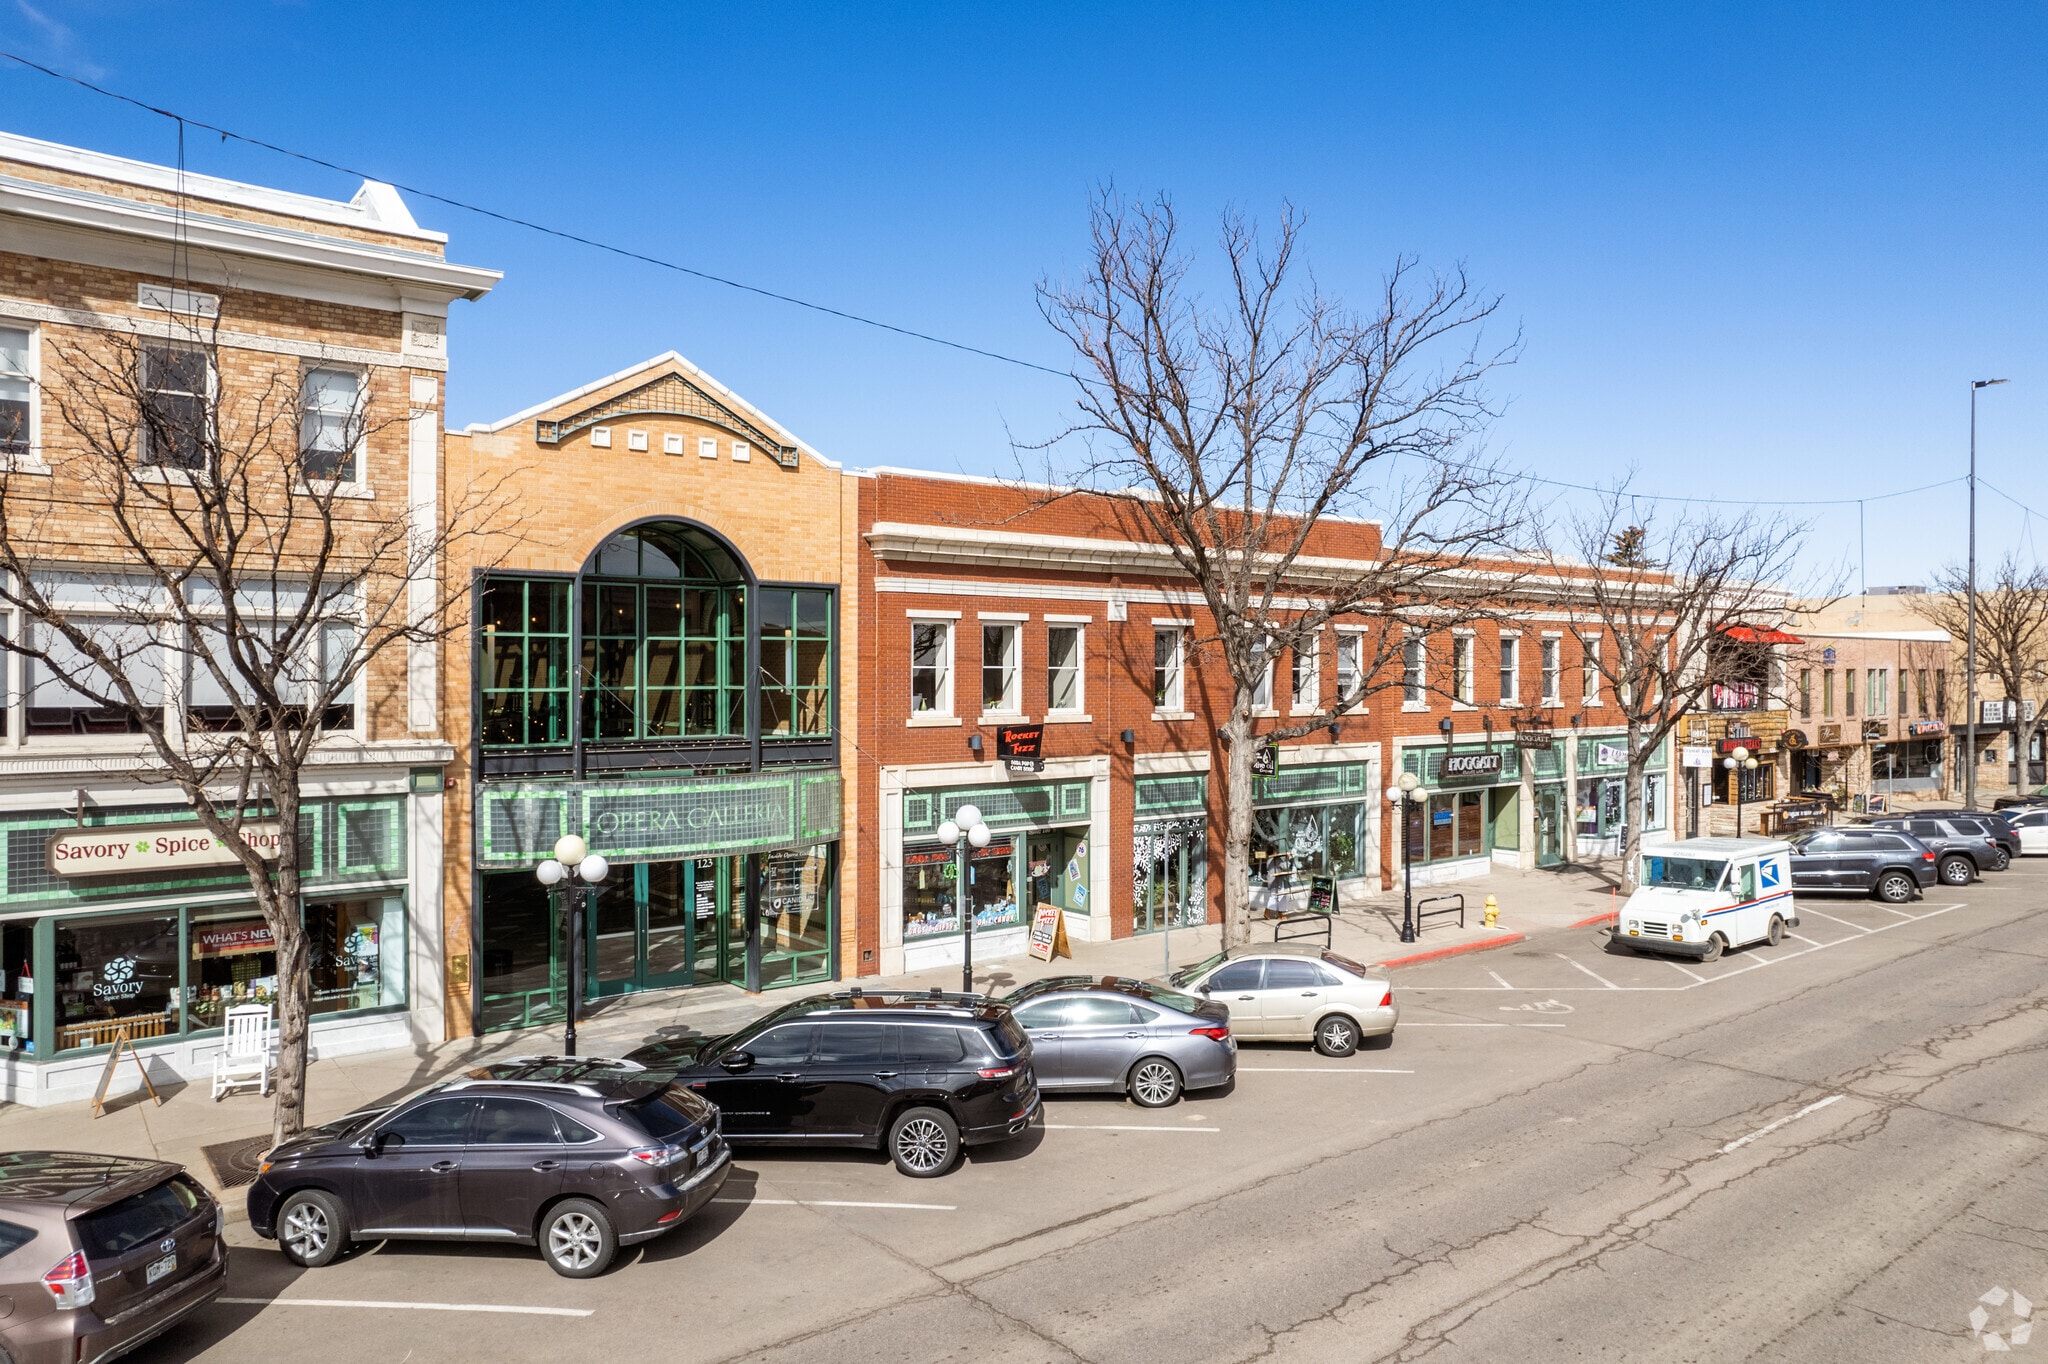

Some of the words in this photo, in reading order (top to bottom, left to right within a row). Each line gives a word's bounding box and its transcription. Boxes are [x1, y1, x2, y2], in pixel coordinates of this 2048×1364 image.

[1003, 730, 1040, 743] ROCKET
[1010, 742, 1036, 755] FIZZ
[1448, 755, 1500, 771] HOGGATT
[596, 808, 681, 834] OPERA
[687, 802, 786, 830] GALLERIA
[55, 842, 130, 861] Savory
[155, 836, 210, 856] Spice
[238, 832, 281, 849] hop
[697, 858, 713, 869] 123
[203, 931, 248, 944] WHAT'S
[93, 981, 144, 997] Savory
